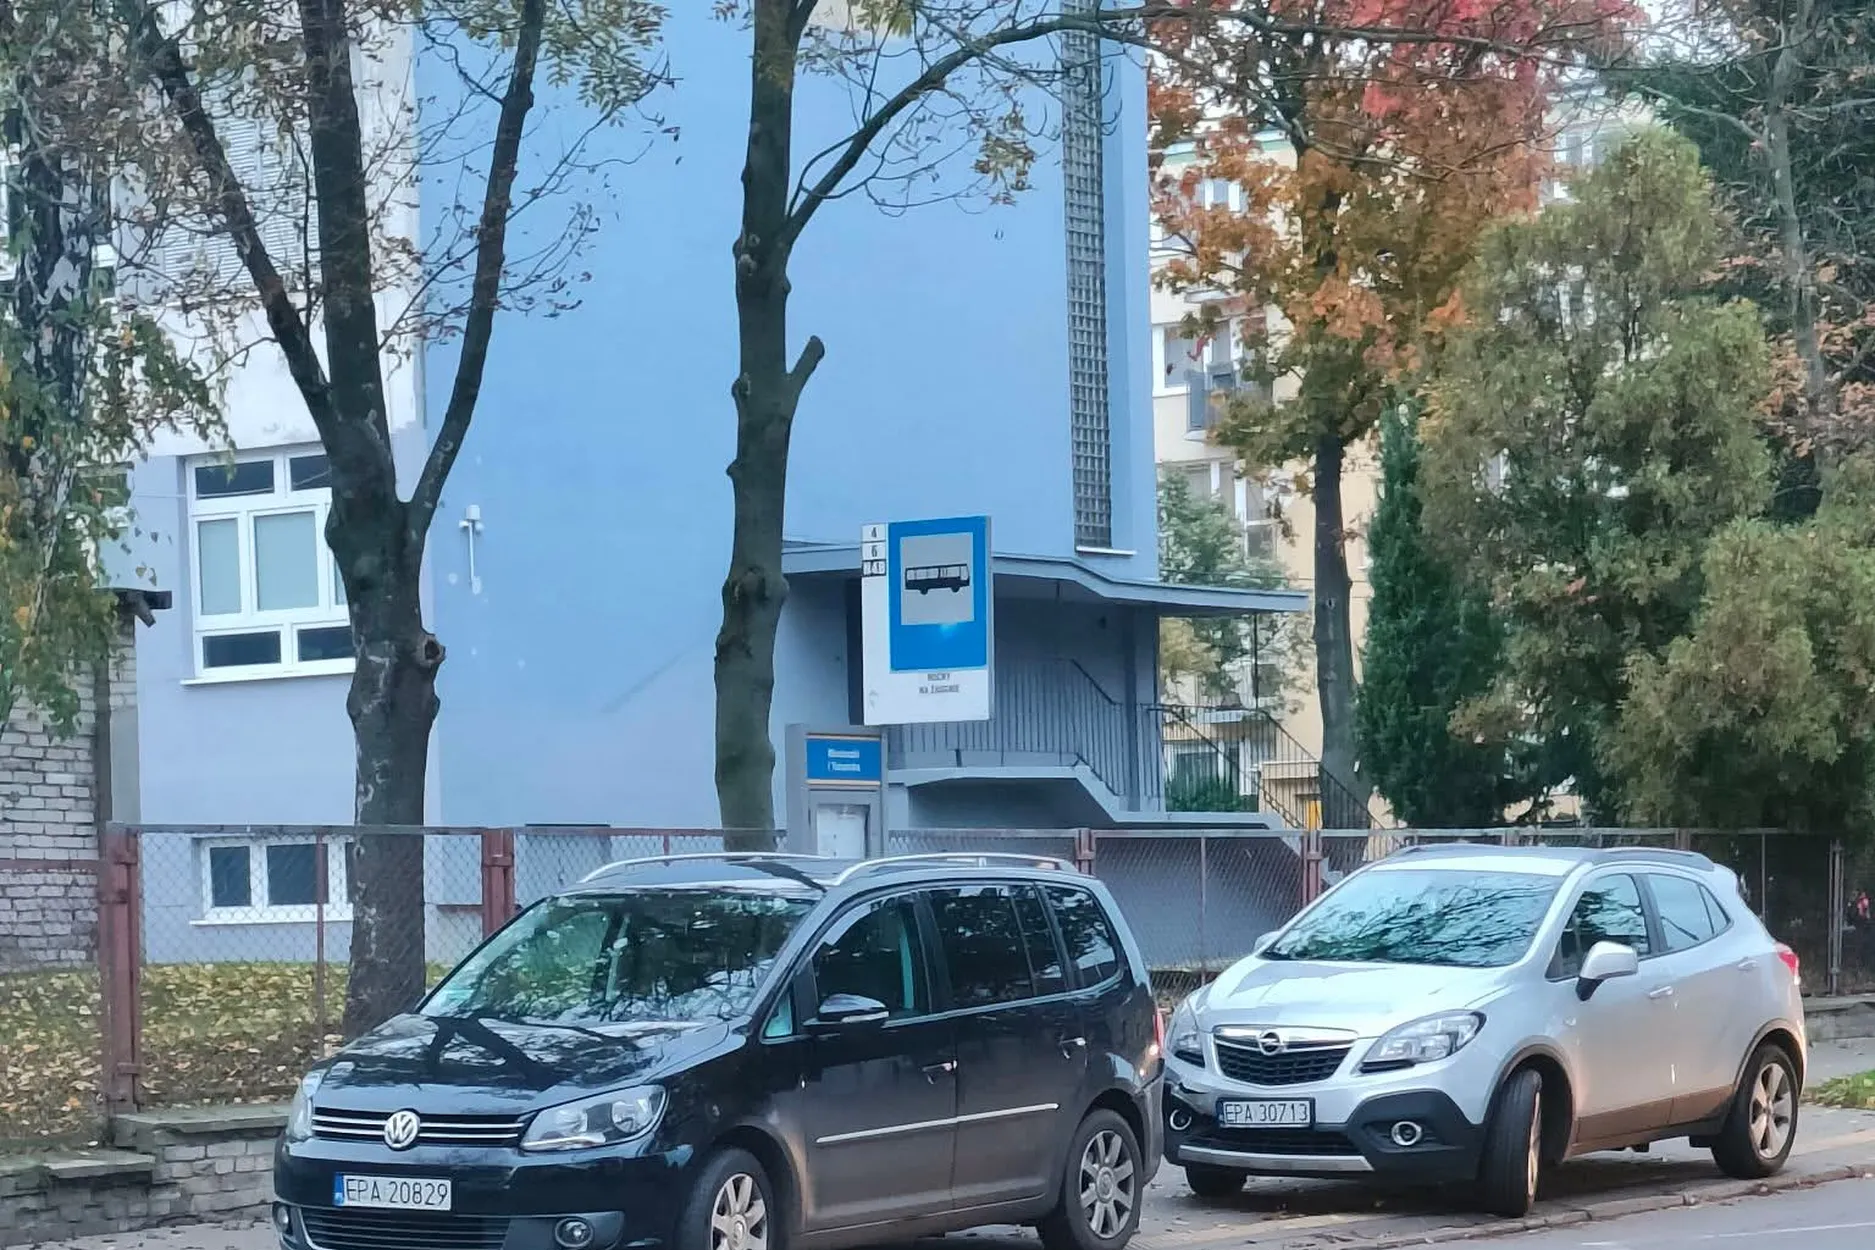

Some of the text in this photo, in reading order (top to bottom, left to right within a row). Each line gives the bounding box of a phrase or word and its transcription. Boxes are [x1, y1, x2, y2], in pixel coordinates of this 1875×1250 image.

[871, 526, 878, 538] 4
[871, 545, 878, 558] 6
[1224, 1103, 1308, 1122] EPA 30713
[346, 1179, 381, 1202] EPA
[388, 1180, 448, 1206] 20829
